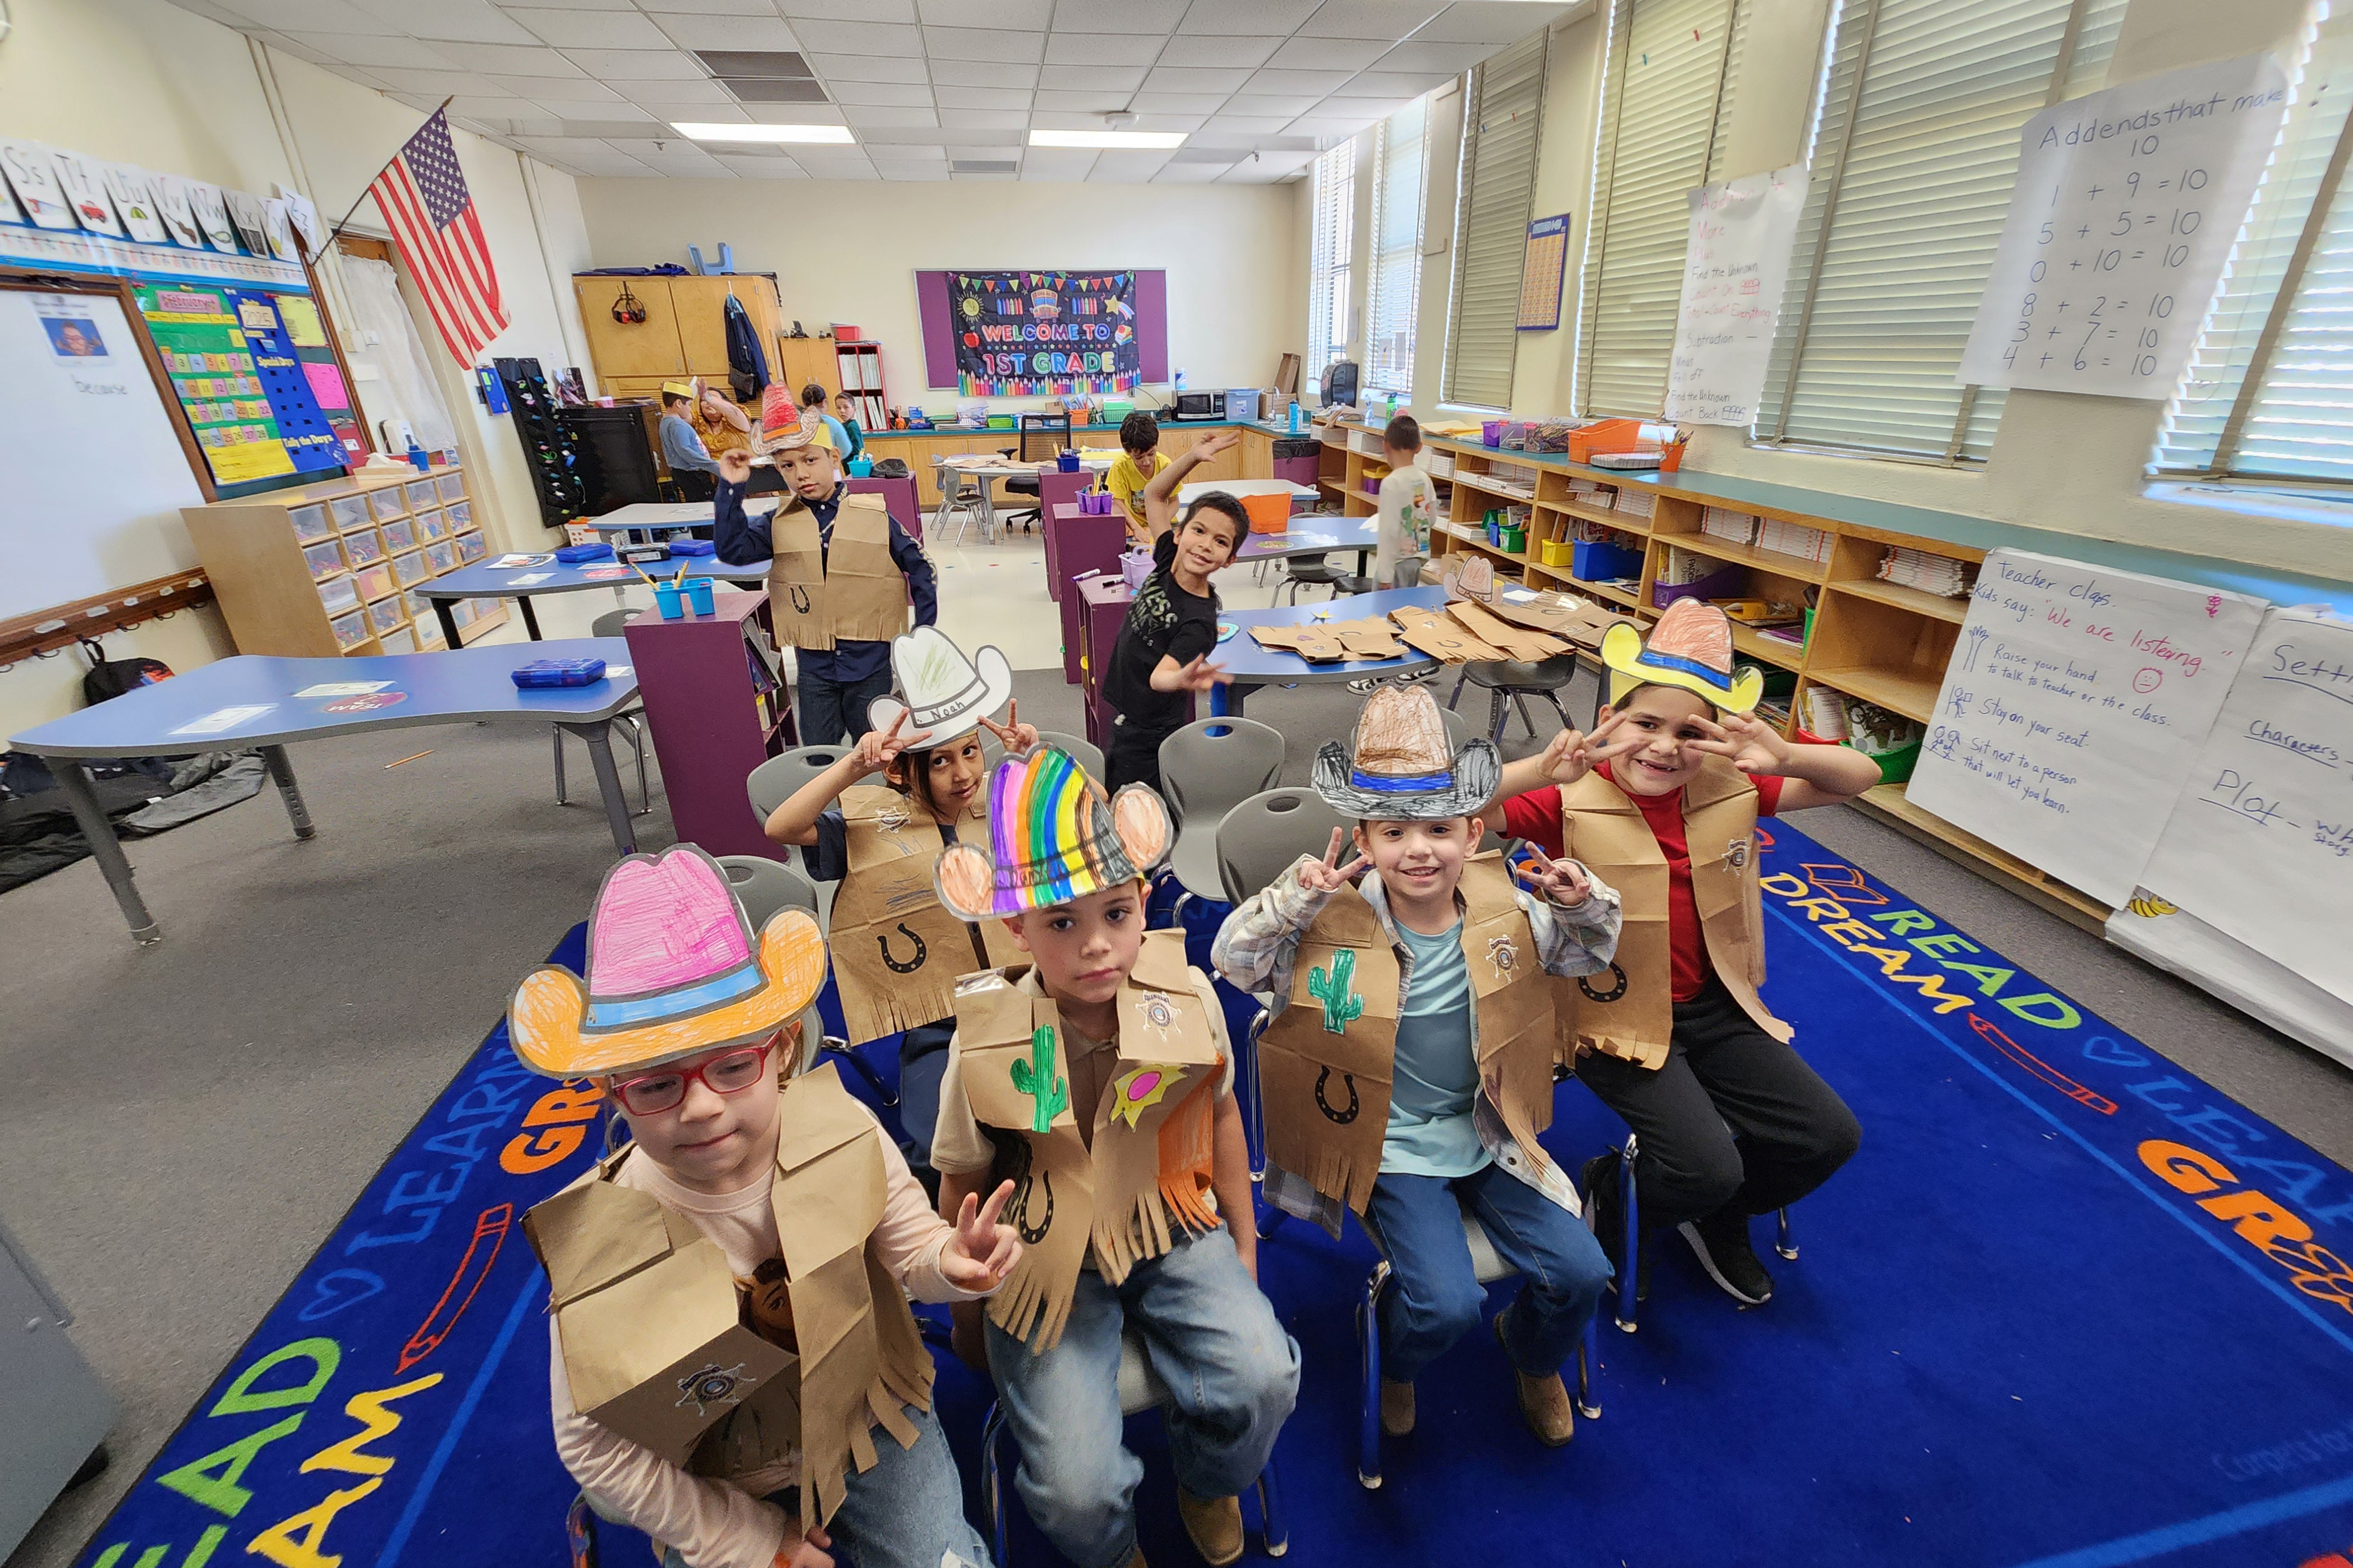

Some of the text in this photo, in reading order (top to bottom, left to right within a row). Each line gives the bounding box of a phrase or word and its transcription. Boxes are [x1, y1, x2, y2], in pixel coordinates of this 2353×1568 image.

[2039, 89, 2285, 150] Addends that make
[2131, 134, 2159, 158] 10
[2051, 185, 2059, 206] 1
[2127, 172, 2141, 198] 9
[2179, 169, 2208, 192] 10
[1697, 222, 1725, 240] More
[2038, 222, 2054, 245] 5
[2111, 211, 2131, 236] 5
[2171, 208, 2201, 235] 10
[1691, 262, 1758, 281] Find the Unknown
[2031, 261, 2047, 282] 0
[2093, 249, 2121, 272] 10
[2162, 243, 2189, 268] 10
[244, 310, 272, 326] 2025
[1730, 303, 1771, 324] Everything
[2021, 293, 2037, 317] 8
[2090, 296, 2106, 316] 2
[2148, 293, 2174, 318] 10
[981, 323, 1111, 342] WELCOME TO
[1686, 333, 1733, 348] Subtraction
[2011, 321, 2031, 342] 3
[2083, 321, 2101, 345] 7
[2138, 326, 2158, 348] 10
[982, 351, 1115, 375] 1ST GRADE
[2003, 346, 2018, 369] 4
[2074, 346, 2087, 371] 6
[2131, 353, 2157, 376] 10
[1687, 391, 1698, 401] the
[1699, 389, 1729, 403] Unknown
[1699, 406, 1718, 419] Back
[1998, 561, 2057, 589] Teacher
[1972, 582, 1998, 602] Kids
[2002, 598, 2035, 623] say:
[2085, 623, 2115, 643] are
[1994, 643, 2029, 665] Raise
[2033, 659, 2060, 673] your
[1987, 663, 1999, 674] to
[2001, 666, 2024, 682] talk
[2027, 675, 2038, 687] to
[2081, 693, 2097, 703] or
[2102, 696, 2125, 710] the
[328, 702, 383, 712] TEAM
[929, 701, 965, 720] Noah
[1978, 697, 2008, 726] Stay
[2009, 712, 2024, 724] on
[2025, 720, 2053, 738] your
[2249, 720, 2339, 760] Characters
[1971, 737, 1991, 754] Sit
[1992, 749, 2015, 763] next
[2017, 754, 2029, 768] to
[2039, 767, 2077, 785] person
[1962, 756, 1984, 773] that
[1985, 771, 2004, 782] will
[2007, 775, 2022, 789] let
[2021, 786, 2039, 800] you
[2212, 769, 2284, 825] Plot
[1759, 872, 1975, 1015] DREAM
[1869, 909, 2082, 1029] READ
